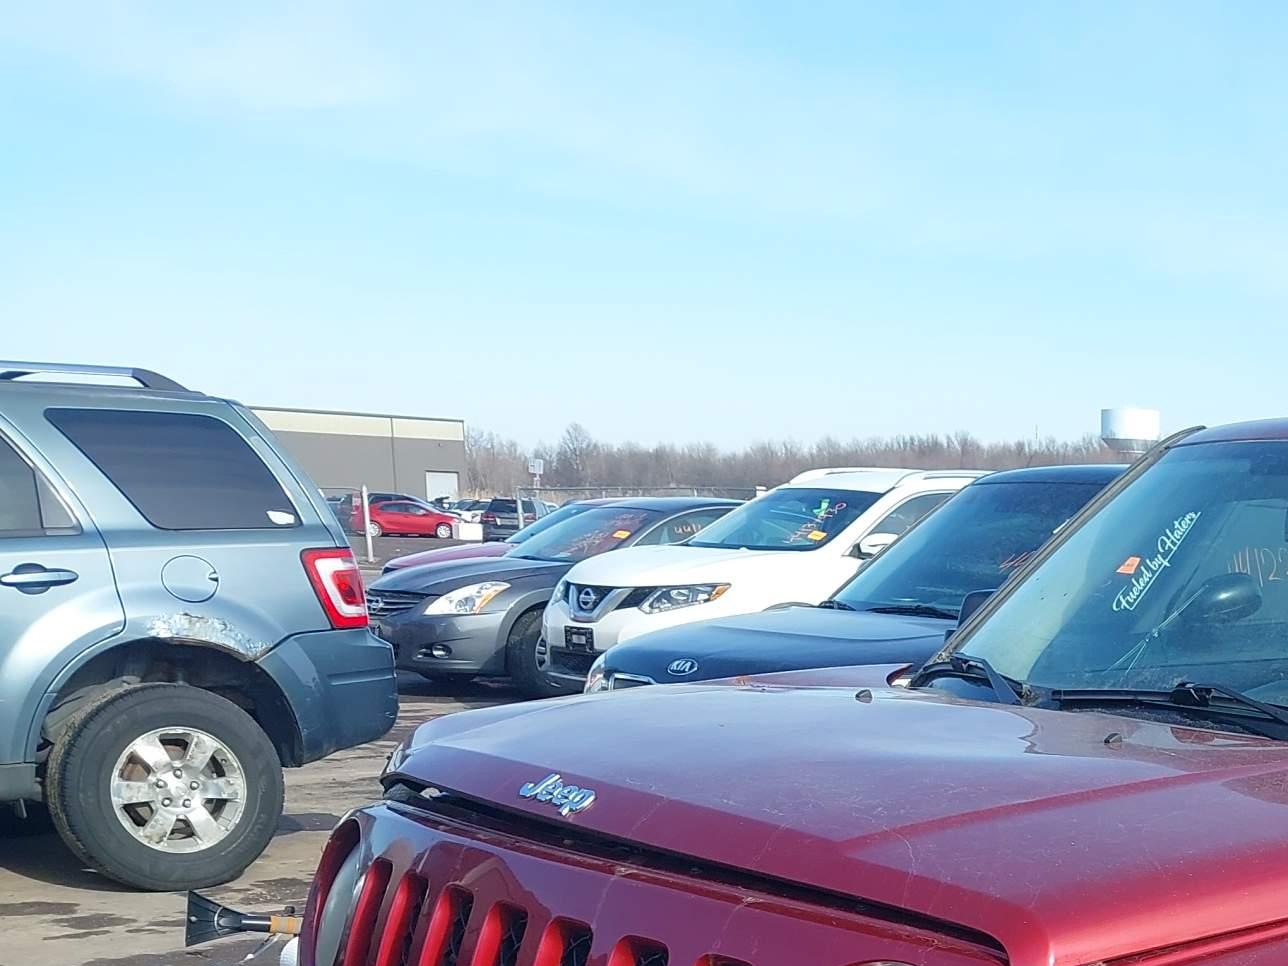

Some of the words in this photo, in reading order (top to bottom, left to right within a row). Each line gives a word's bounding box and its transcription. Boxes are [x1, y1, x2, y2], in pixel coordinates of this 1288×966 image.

[1157, 511, 1197, 554] Haters
[1145, 553, 1171, 571] by
[1112, 565, 1153, 612] Fueled
[670, 660, 692, 672] KIA
[519, 773, 596, 816] Jeep
